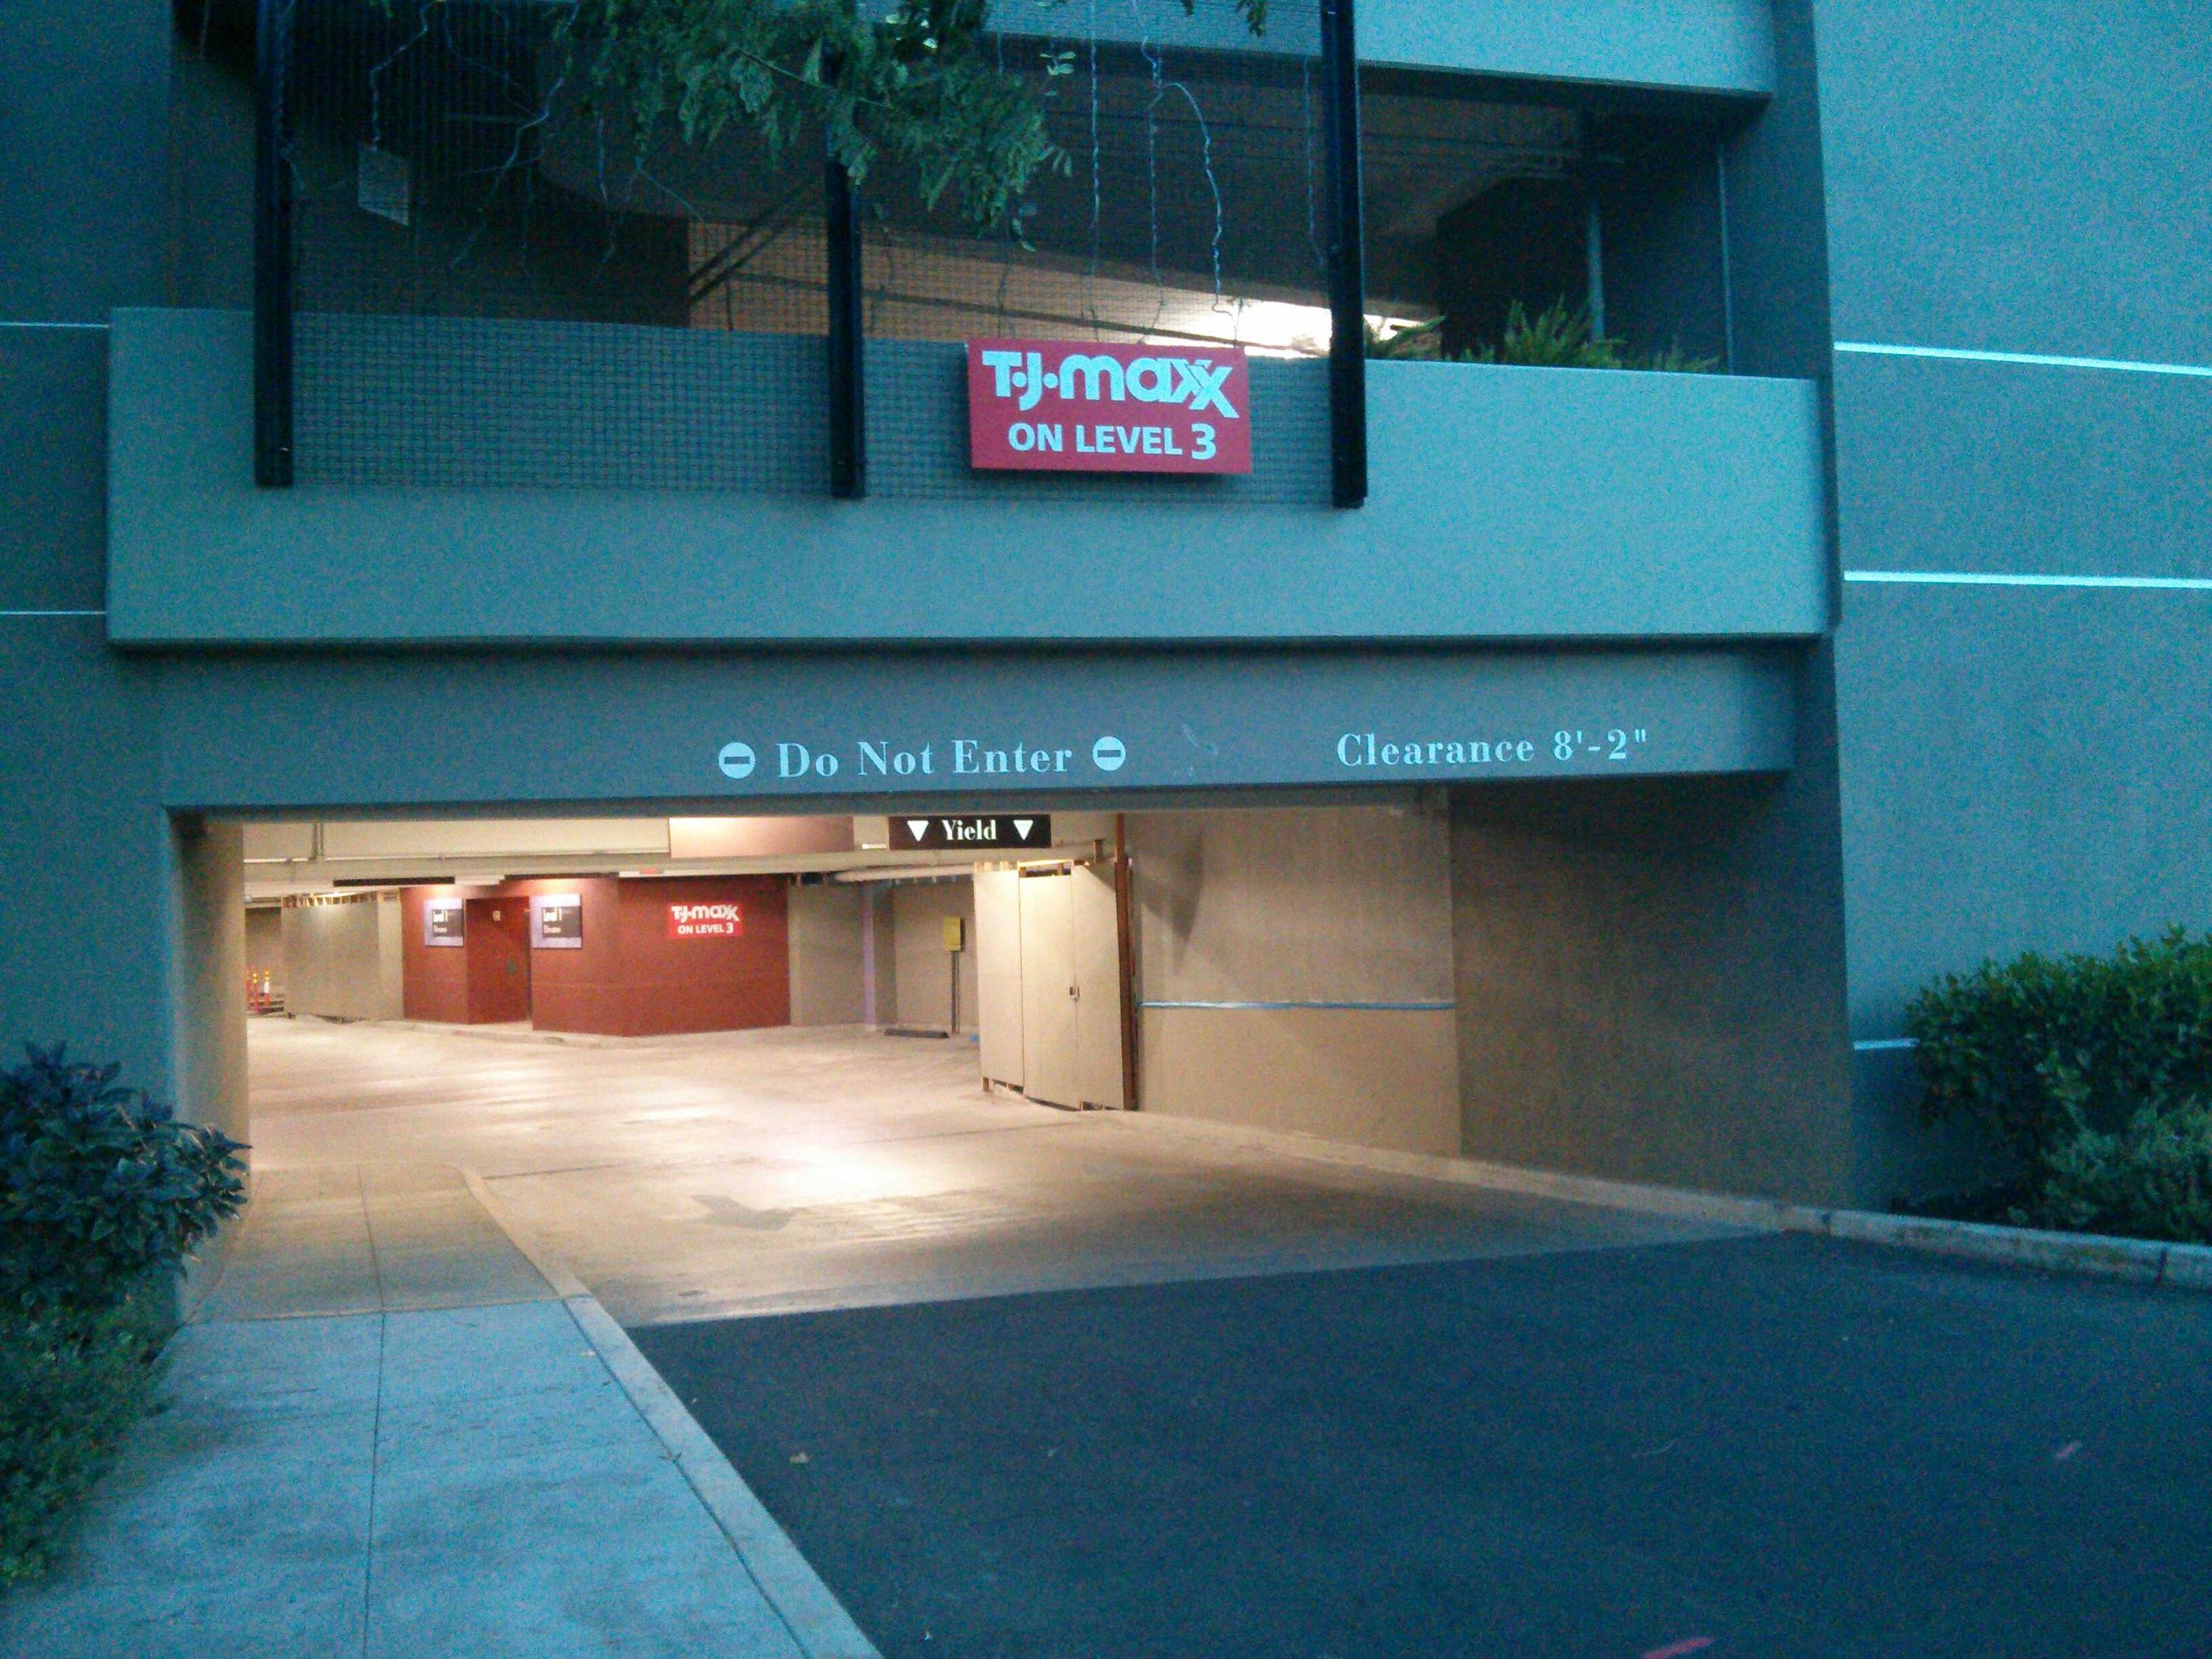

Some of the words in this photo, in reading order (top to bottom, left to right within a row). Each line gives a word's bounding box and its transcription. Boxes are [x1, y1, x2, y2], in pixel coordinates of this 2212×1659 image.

[1009, 422, 1062, 451] ON
[1076, 425, 1182, 455] LEVEL
[1192, 423, 1217, 460] 3
[776, 742, 839, 778] Do
[856, 740, 933, 776] Not
[952, 739, 1072, 774] Enter
[1337, 732, 1535, 767] Clearance
[942, 819, 997, 841] Yield
[678, 925, 693, 935] ON
[695, 923, 725, 934] LEVEL
[726, 922, 734, 934] 3
